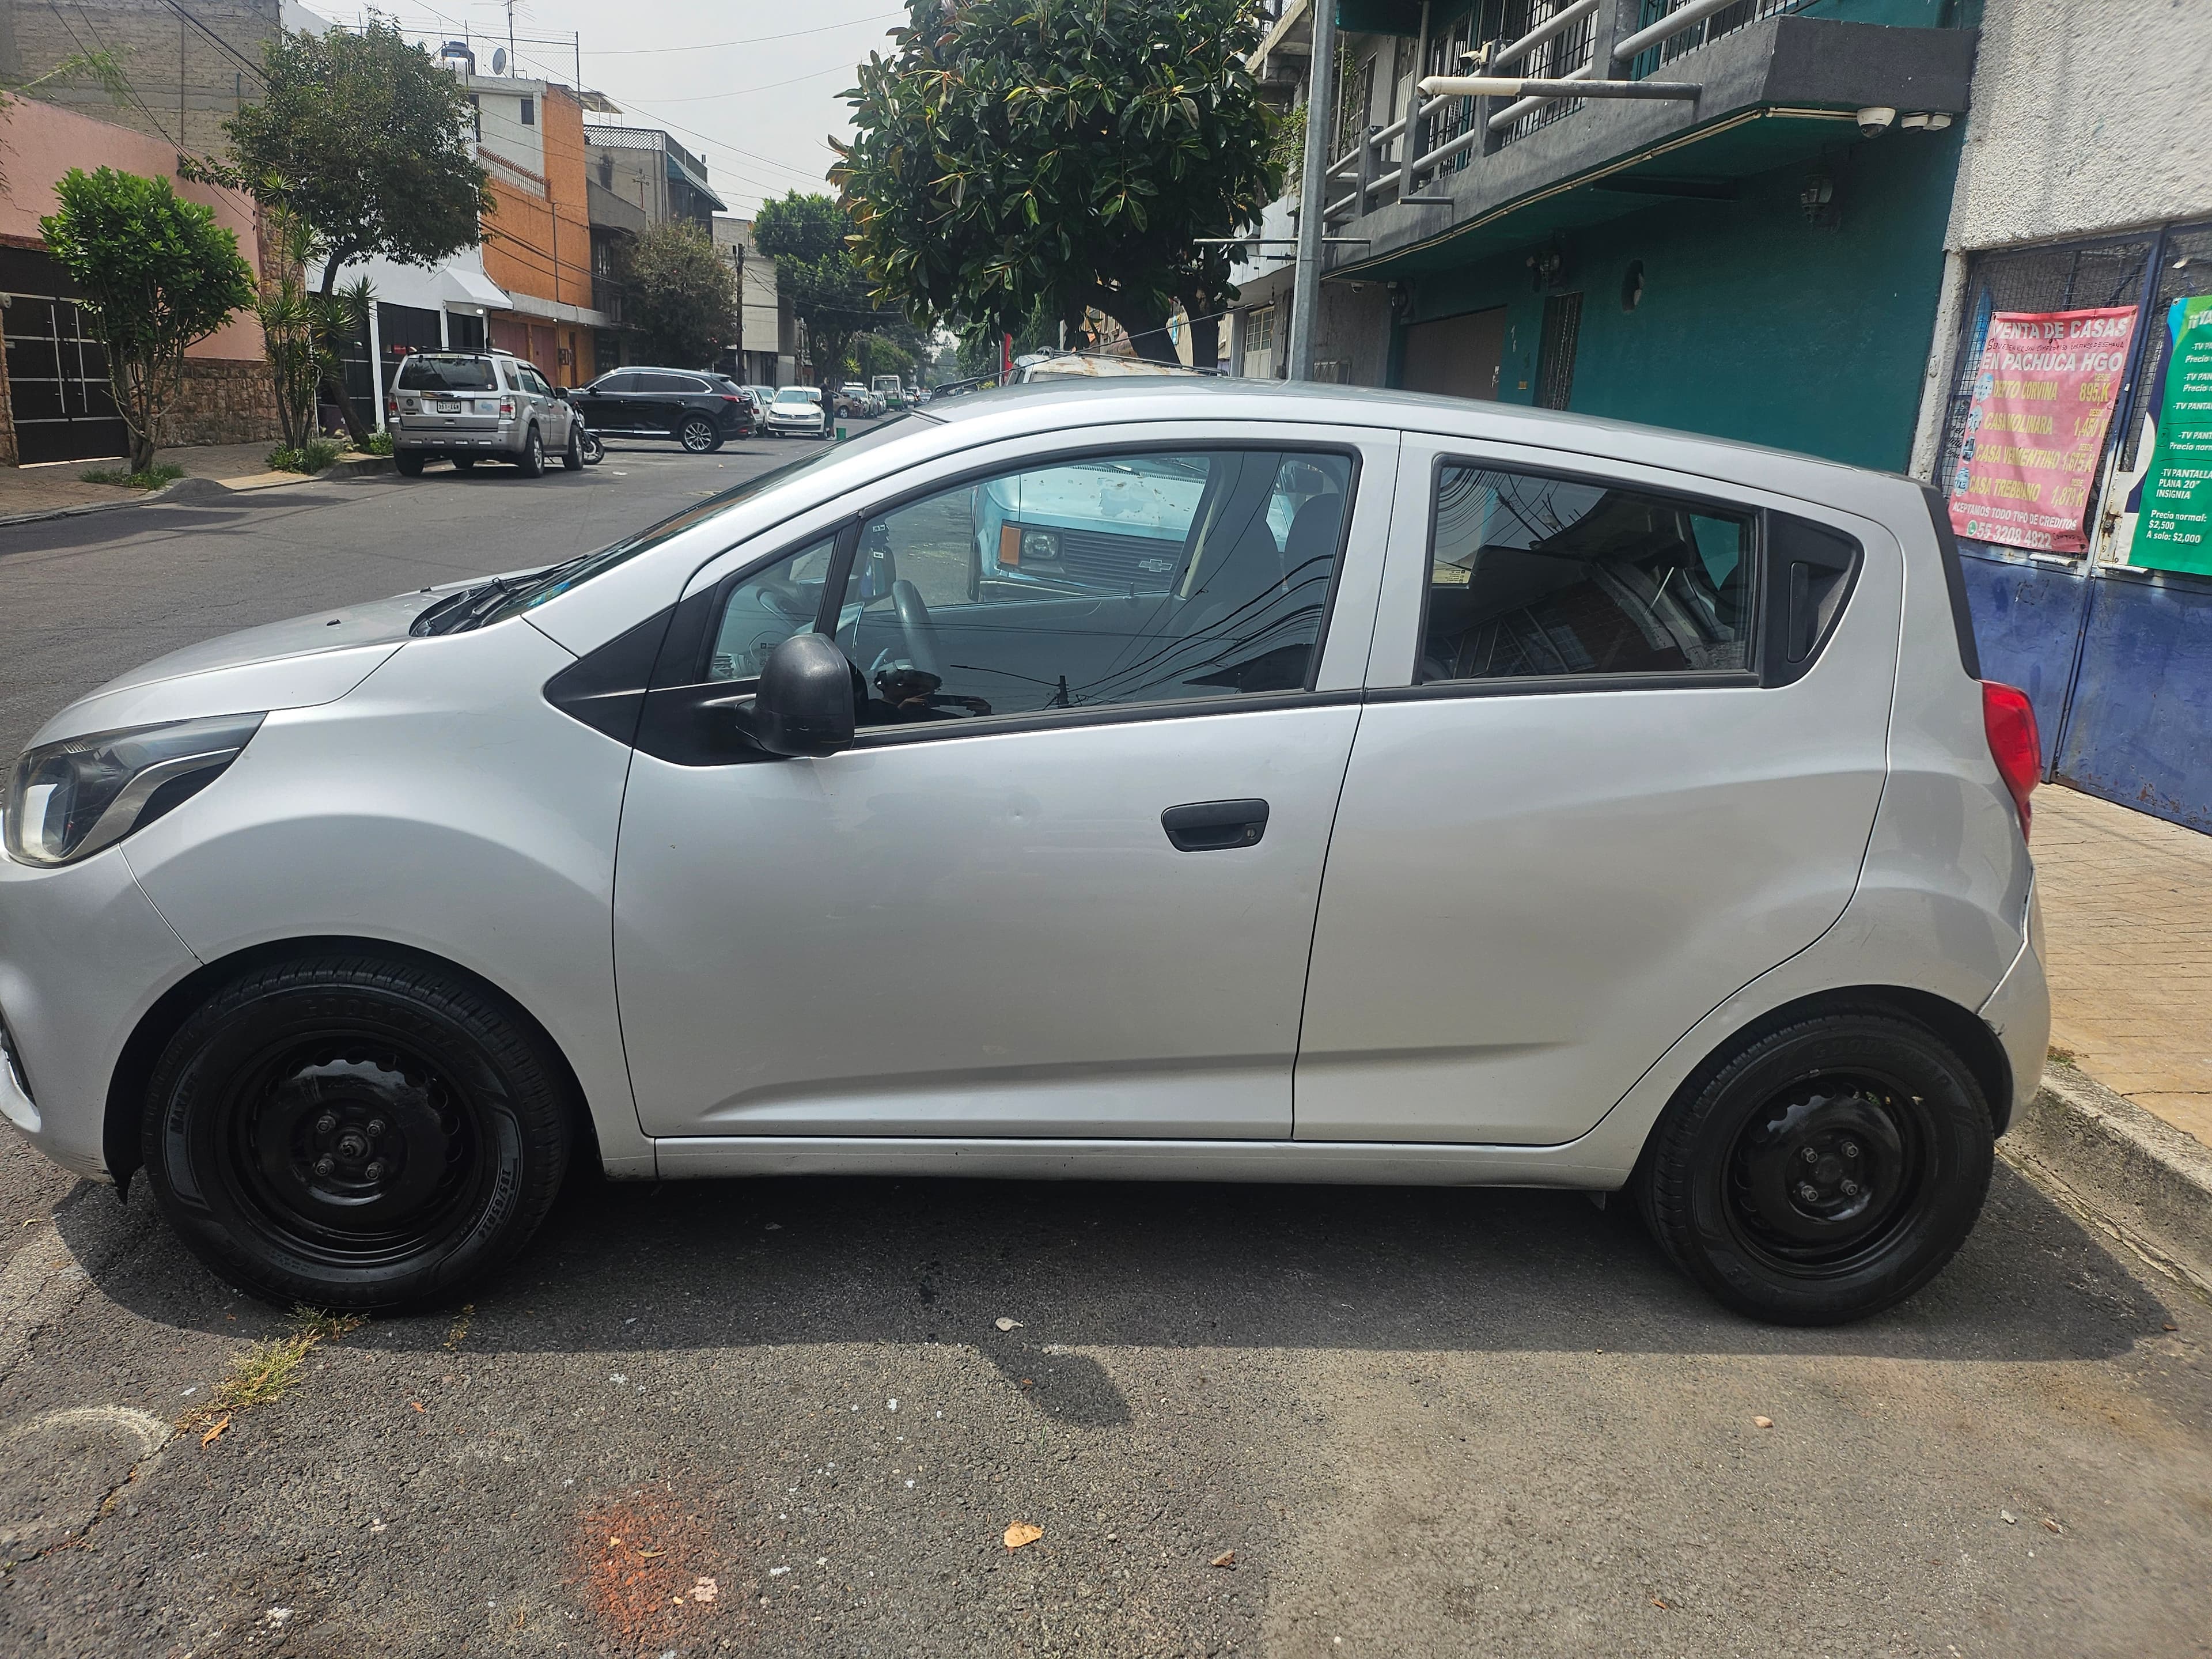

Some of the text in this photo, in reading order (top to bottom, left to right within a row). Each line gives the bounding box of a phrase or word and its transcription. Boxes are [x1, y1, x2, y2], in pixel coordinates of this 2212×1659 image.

[1994, 317, 2130, 339] VENTA DE CASAS
[1982, 352, 2124, 372] EN PACHUCA HGO
[2184, 355, 2209, 363] Precio
[1993, 380, 2021, 399] DEPTO
[2021, 381, 2058, 400] CORVINA
[2172, 402, 2187, 410] -TV
[1983, 412, 2006, 431] CASA
[1976, 444, 2001, 463] CASA
[2169, 442, 2194, 450] Precio
[1969, 475, 1991, 495] CASA
[2158, 479, 2181, 488] PLANA
[2156, 489, 2191, 499] INSIGNIA
[1952, 502, 2078, 531] ACEPTAMOS TODO TIPO DE CREDITOS
[2150, 510, 2207, 522] Precio normal:
[2149, 520, 2175, 530] $2,500
[1977, 522, 1992, 540] 55
[1993, 524, 2021, 544] 3208
[2024, 529, 2052, 550] 4822
[2146, 531, 2201, 543] A solo: $2,000
